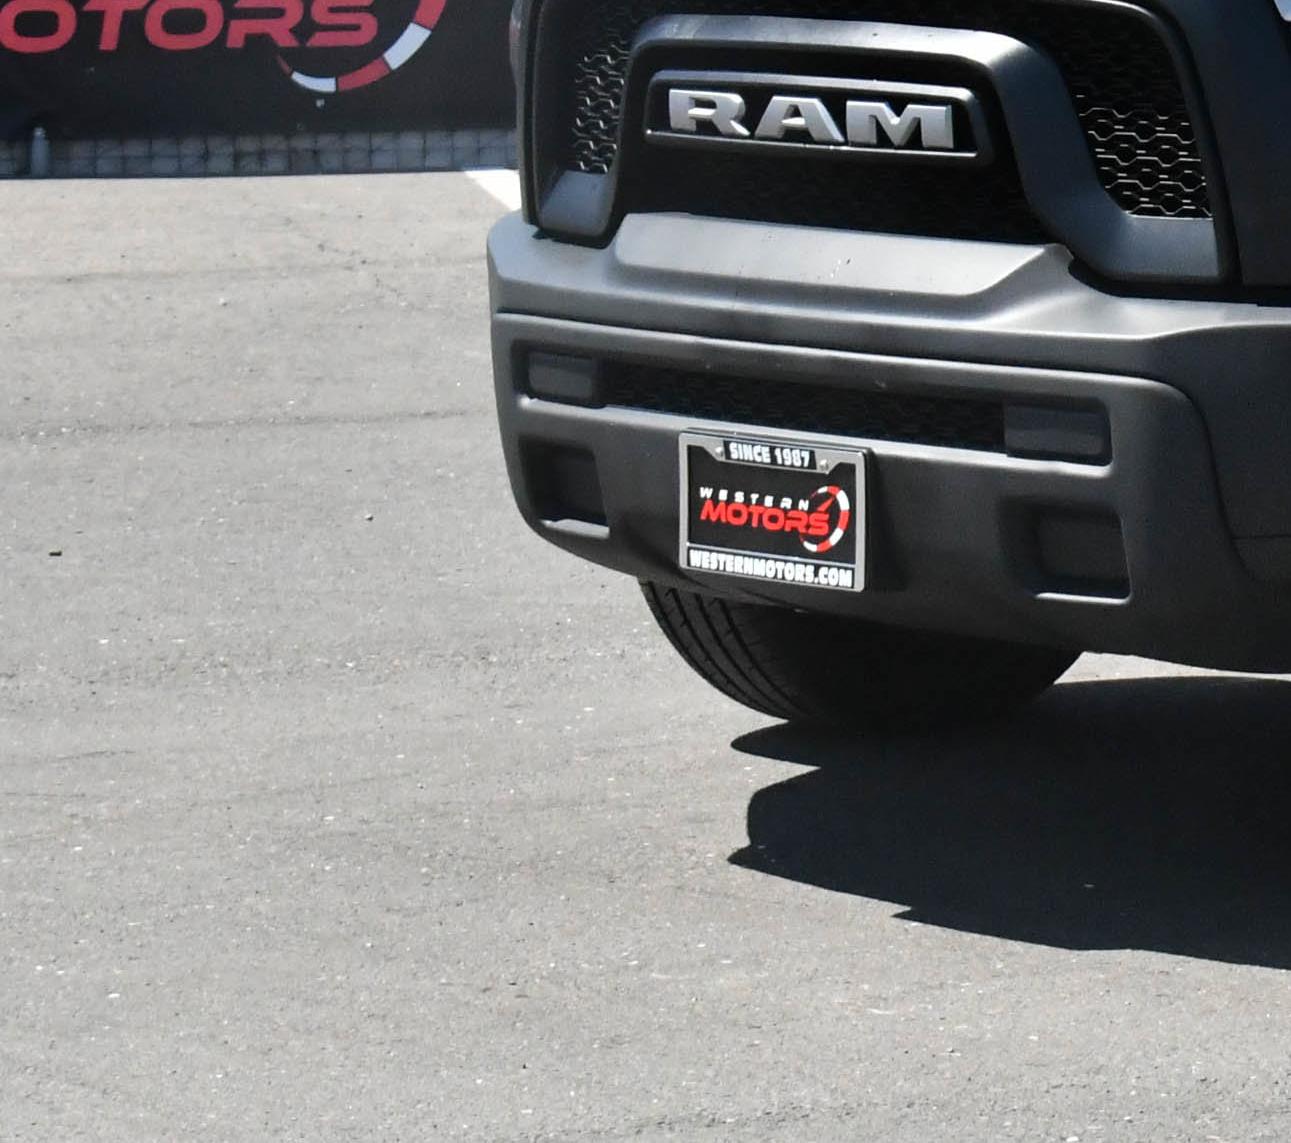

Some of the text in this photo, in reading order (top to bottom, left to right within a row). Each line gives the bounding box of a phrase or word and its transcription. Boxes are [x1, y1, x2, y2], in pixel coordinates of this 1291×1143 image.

[669, 89, 954, 149] RAM
[728, 442, 810, 468] SINCE 1987
[699, 486, 810, 511] WESTERN
[700, 499, 831, 536] MOTORS
[689, 548, 853, 587] WESTERNMOTORS.COM
